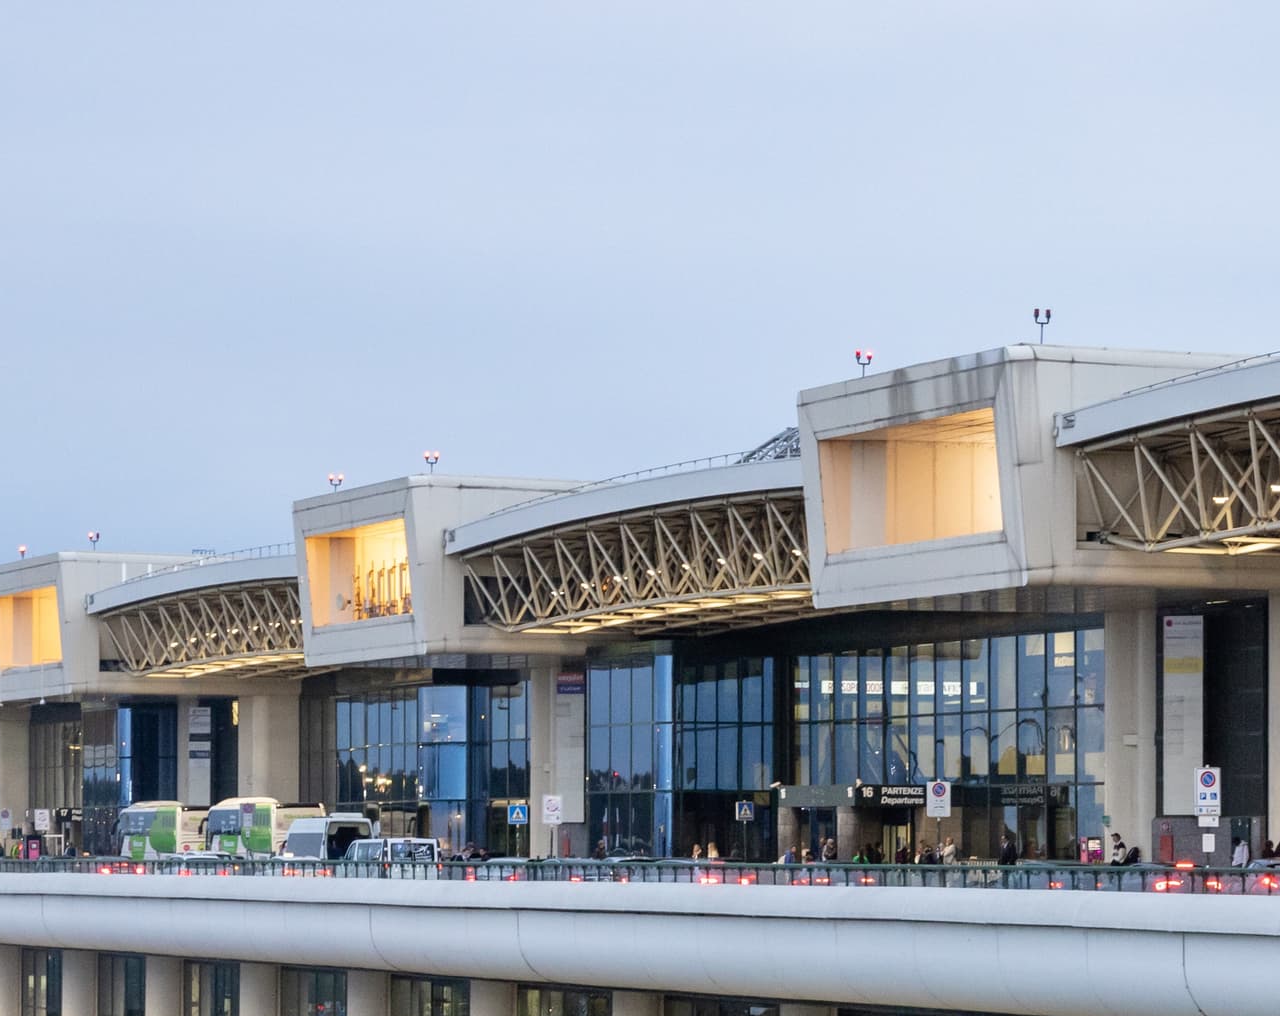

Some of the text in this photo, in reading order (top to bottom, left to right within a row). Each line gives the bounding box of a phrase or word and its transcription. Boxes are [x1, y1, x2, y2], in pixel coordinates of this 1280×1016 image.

[861, 787, 924, 798] 16 PARTENZE
[880, 796, 924, 805] Departures
[61, 808, 69, 817] 17
